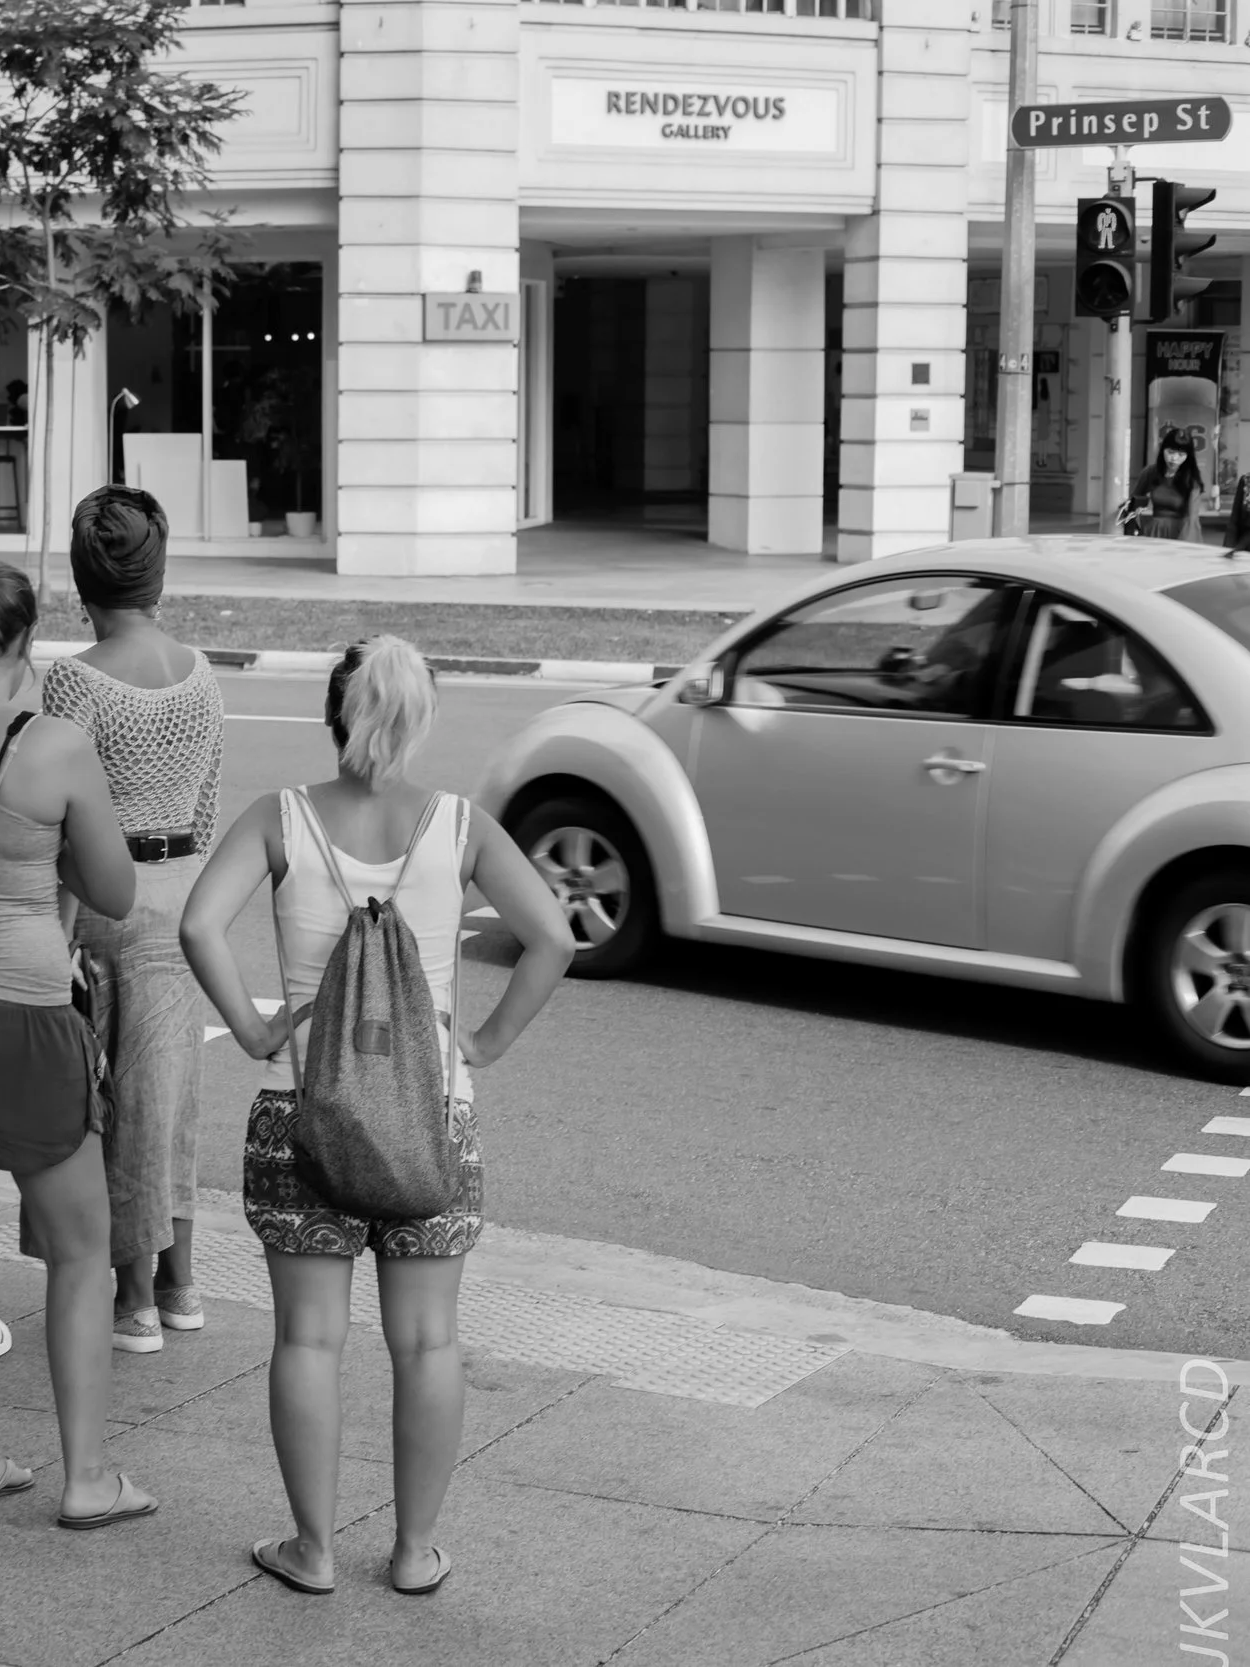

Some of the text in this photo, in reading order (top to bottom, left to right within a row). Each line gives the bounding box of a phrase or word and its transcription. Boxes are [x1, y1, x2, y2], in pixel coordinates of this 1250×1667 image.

[607, 91, 786, 120] RENDEZVOUS
[661, 123, 732, 140] GALLERY
[1030, 103, 1212, 139] Prinsep St
[436, 302, 510, 331] TAXI
[1156, 341, 1213, 359] HAPPY
